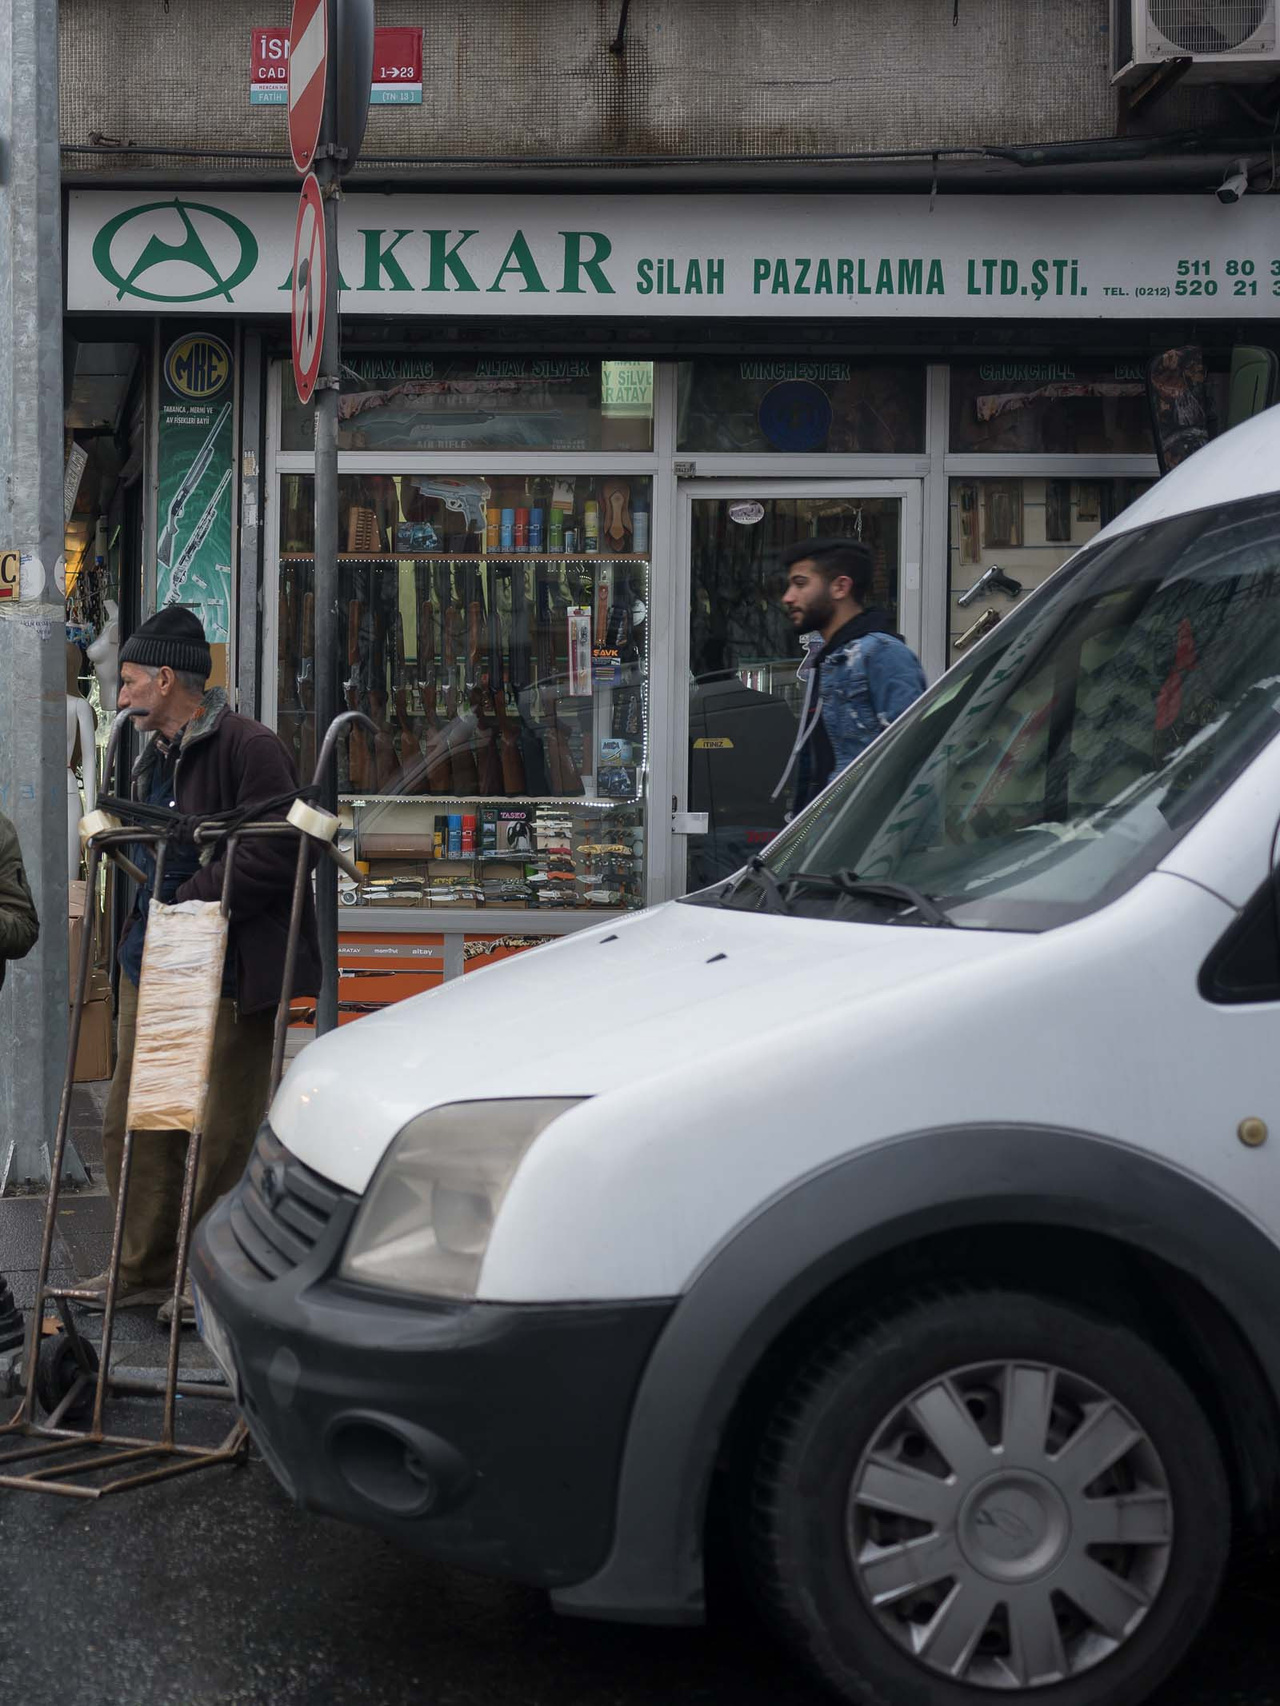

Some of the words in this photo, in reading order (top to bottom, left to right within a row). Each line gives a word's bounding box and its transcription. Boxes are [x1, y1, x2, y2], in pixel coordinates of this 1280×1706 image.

[258, 92, 282, 101] FATİH
[753, 257, 946, 297] PAZARLAMA
[1176, 260, 1211, 276] 511
[1225, 260, 1255, 276] 80
[1103, 287, 1129, 296] TEL.
[1135, 287, 1171, 298] (0212)
[1175, 280, 1218, 296] 520
[1233, 280, 1257, 296] 21
[175, 342, 224, 392] MKE
[476, 360, 525, 378] ALTAY
[739, 361, 851, 381] WINCHESTER
[978, 362, 1076, 382] CHURCHILL
